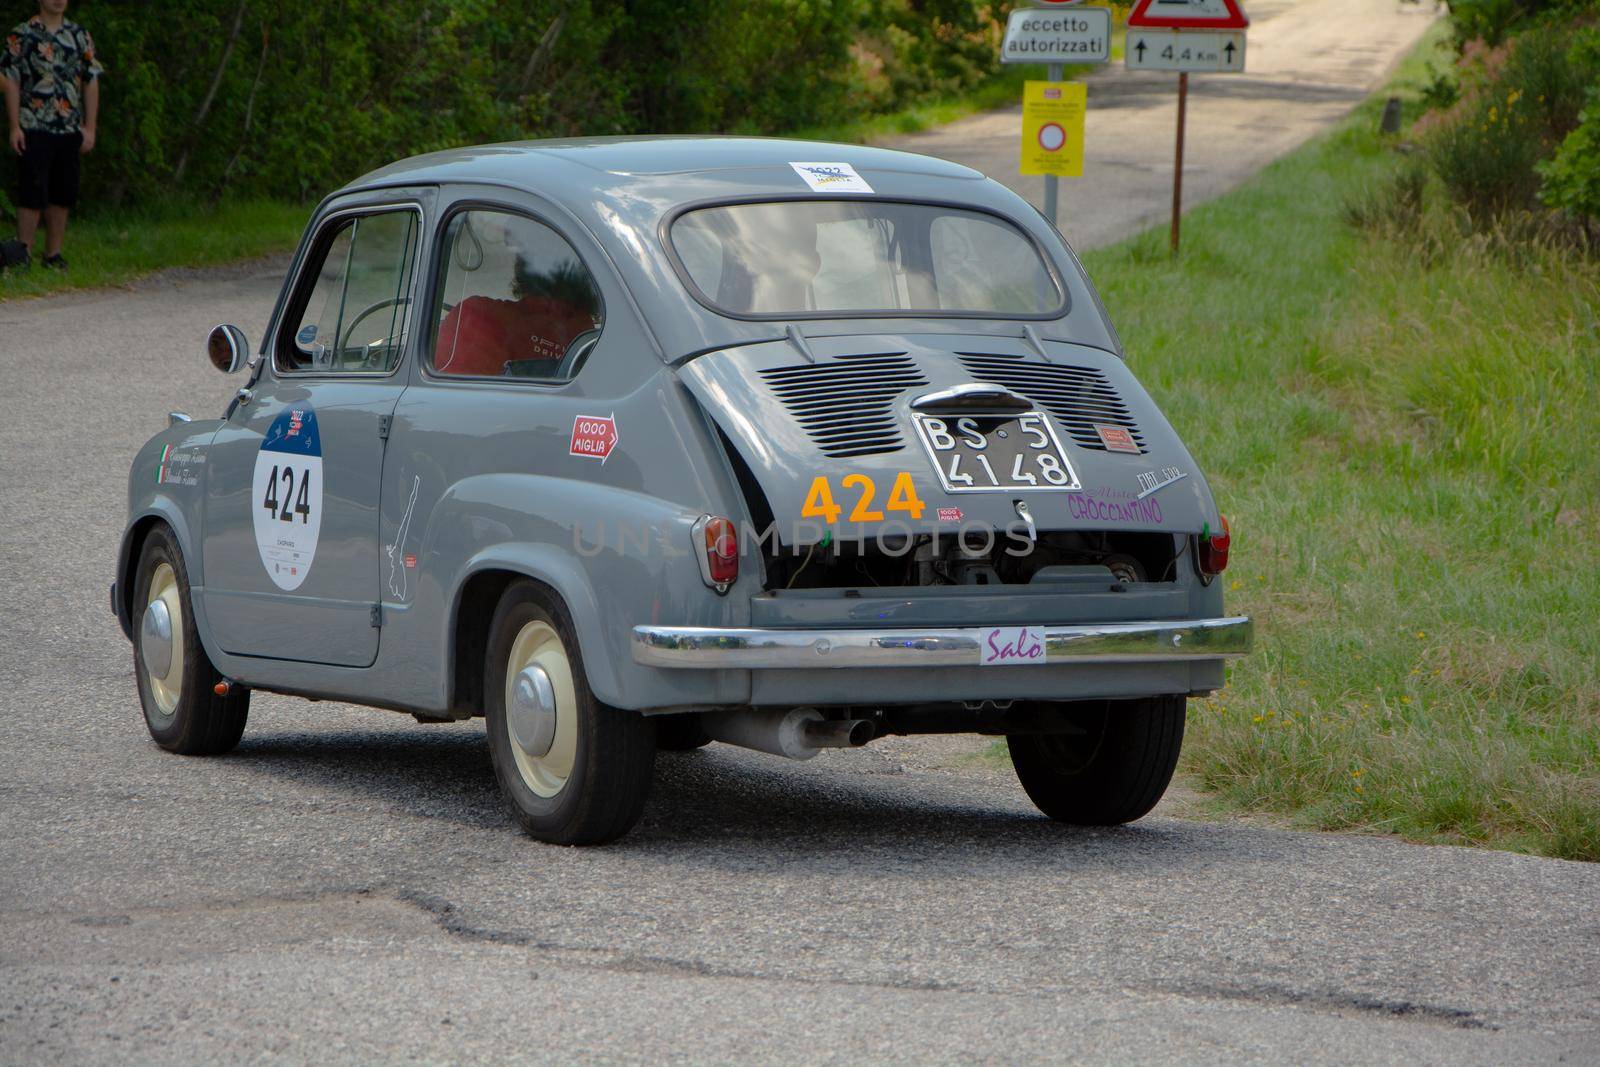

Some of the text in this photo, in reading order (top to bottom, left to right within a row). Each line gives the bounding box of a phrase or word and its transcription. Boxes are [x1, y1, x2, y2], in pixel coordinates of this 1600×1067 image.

[1022, 17, 1088, 32] eccetto
[1009, 38, 1102, 53] autorizzati
[1161, 45, 1191, 63] 4,4
[580, 422, 606, 435] 1000
[923, 418, 1048, 450] BS 5
[574, 438, 605, 453] MIGLIA
[1136, 471, 1158, 492] FIAT
[264, 465, 310, 524] 424
[801, 472, 926, 525] 424
[1068, 494, 1163, 524] CROCCANTINO
[987, 628, 1041, 662] Salò
